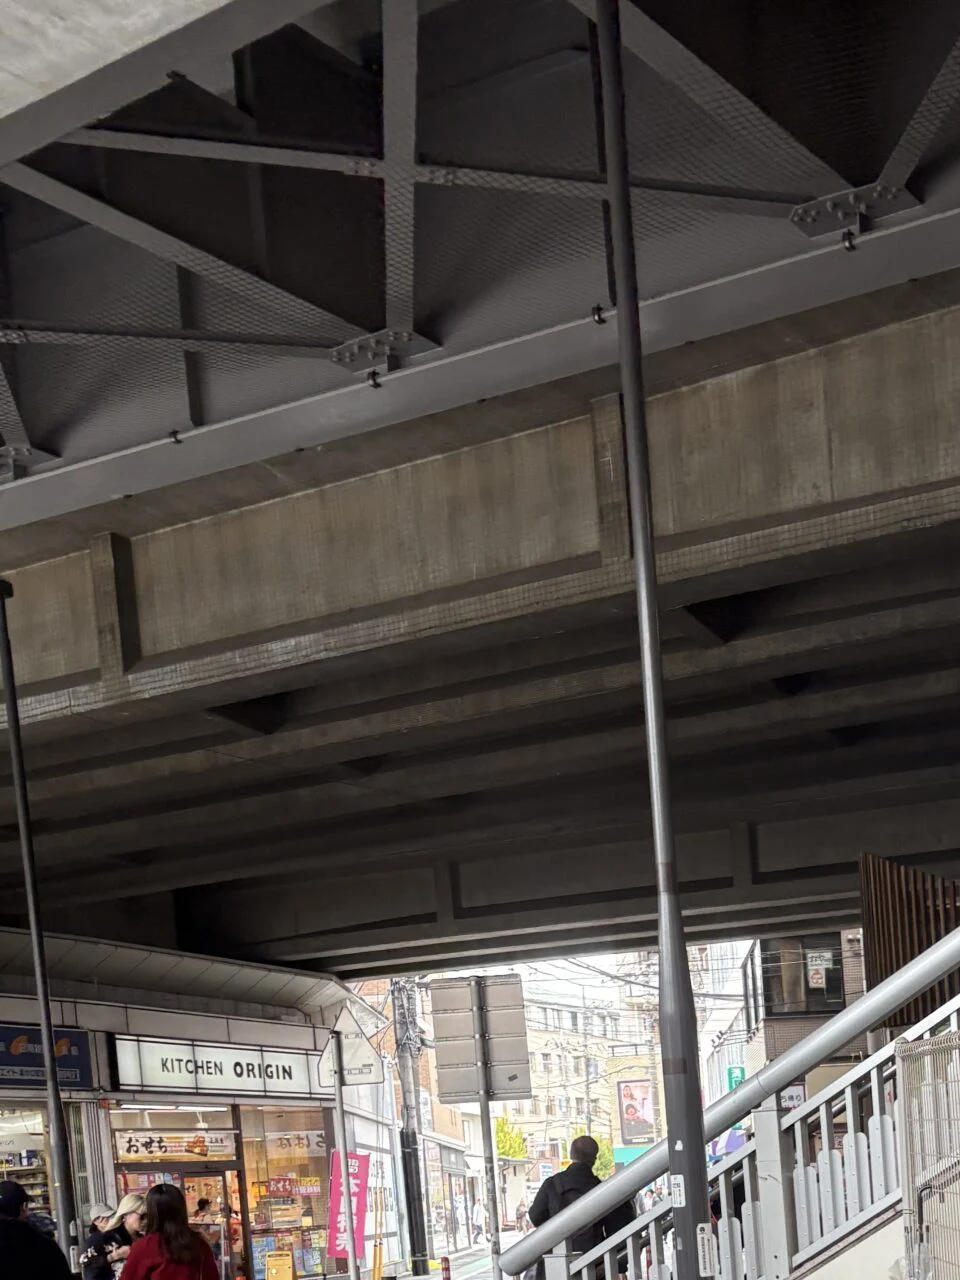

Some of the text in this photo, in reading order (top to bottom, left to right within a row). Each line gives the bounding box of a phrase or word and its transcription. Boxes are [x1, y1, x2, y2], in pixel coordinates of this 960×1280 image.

[161, 1057, 293, 1080] KITCHEN ORIGIN
[126, 1136, 168, 1154] おせち
